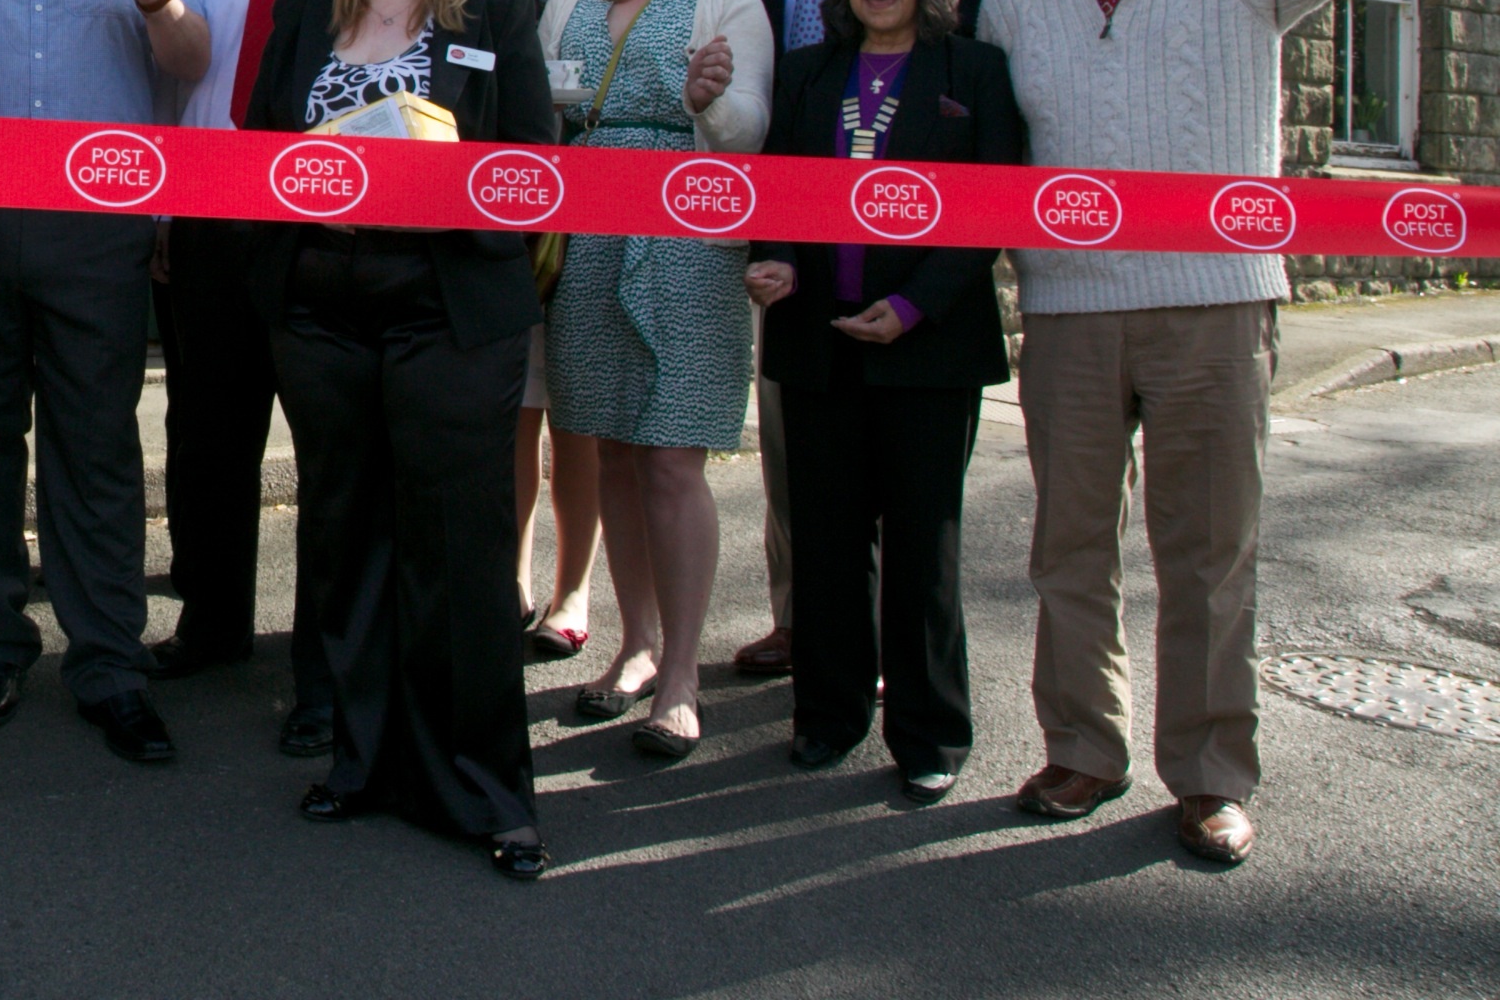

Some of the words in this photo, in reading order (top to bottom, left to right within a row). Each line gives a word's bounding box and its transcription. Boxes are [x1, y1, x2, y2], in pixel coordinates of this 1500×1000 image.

[92, 147, 144, 166] POST
[78, 166, 150, 186] OFFICE
[295, 158, 346, 176] POST
[492, 167, 542, 185] POST
[282, 176, 353, 196] OFFICE
[686, 176, 734, 193] POST
[874, 184, 920, 200] POST
[480, 186, 549, 205] OFFICE
[674, 194, 741, 212] OFFICE
[1056, 190, 1101, 207] POST
[863, 202, 928, 220] OFFICE
[1231, 197, 1276, 214] POST
[1404, 203, 1447, 220] POST
[1046, 208, 1109, 226] OFFICE
[1221, 215, 1284, 232] OFFICE
[1394, 221, 1455, 237] OFFICE
